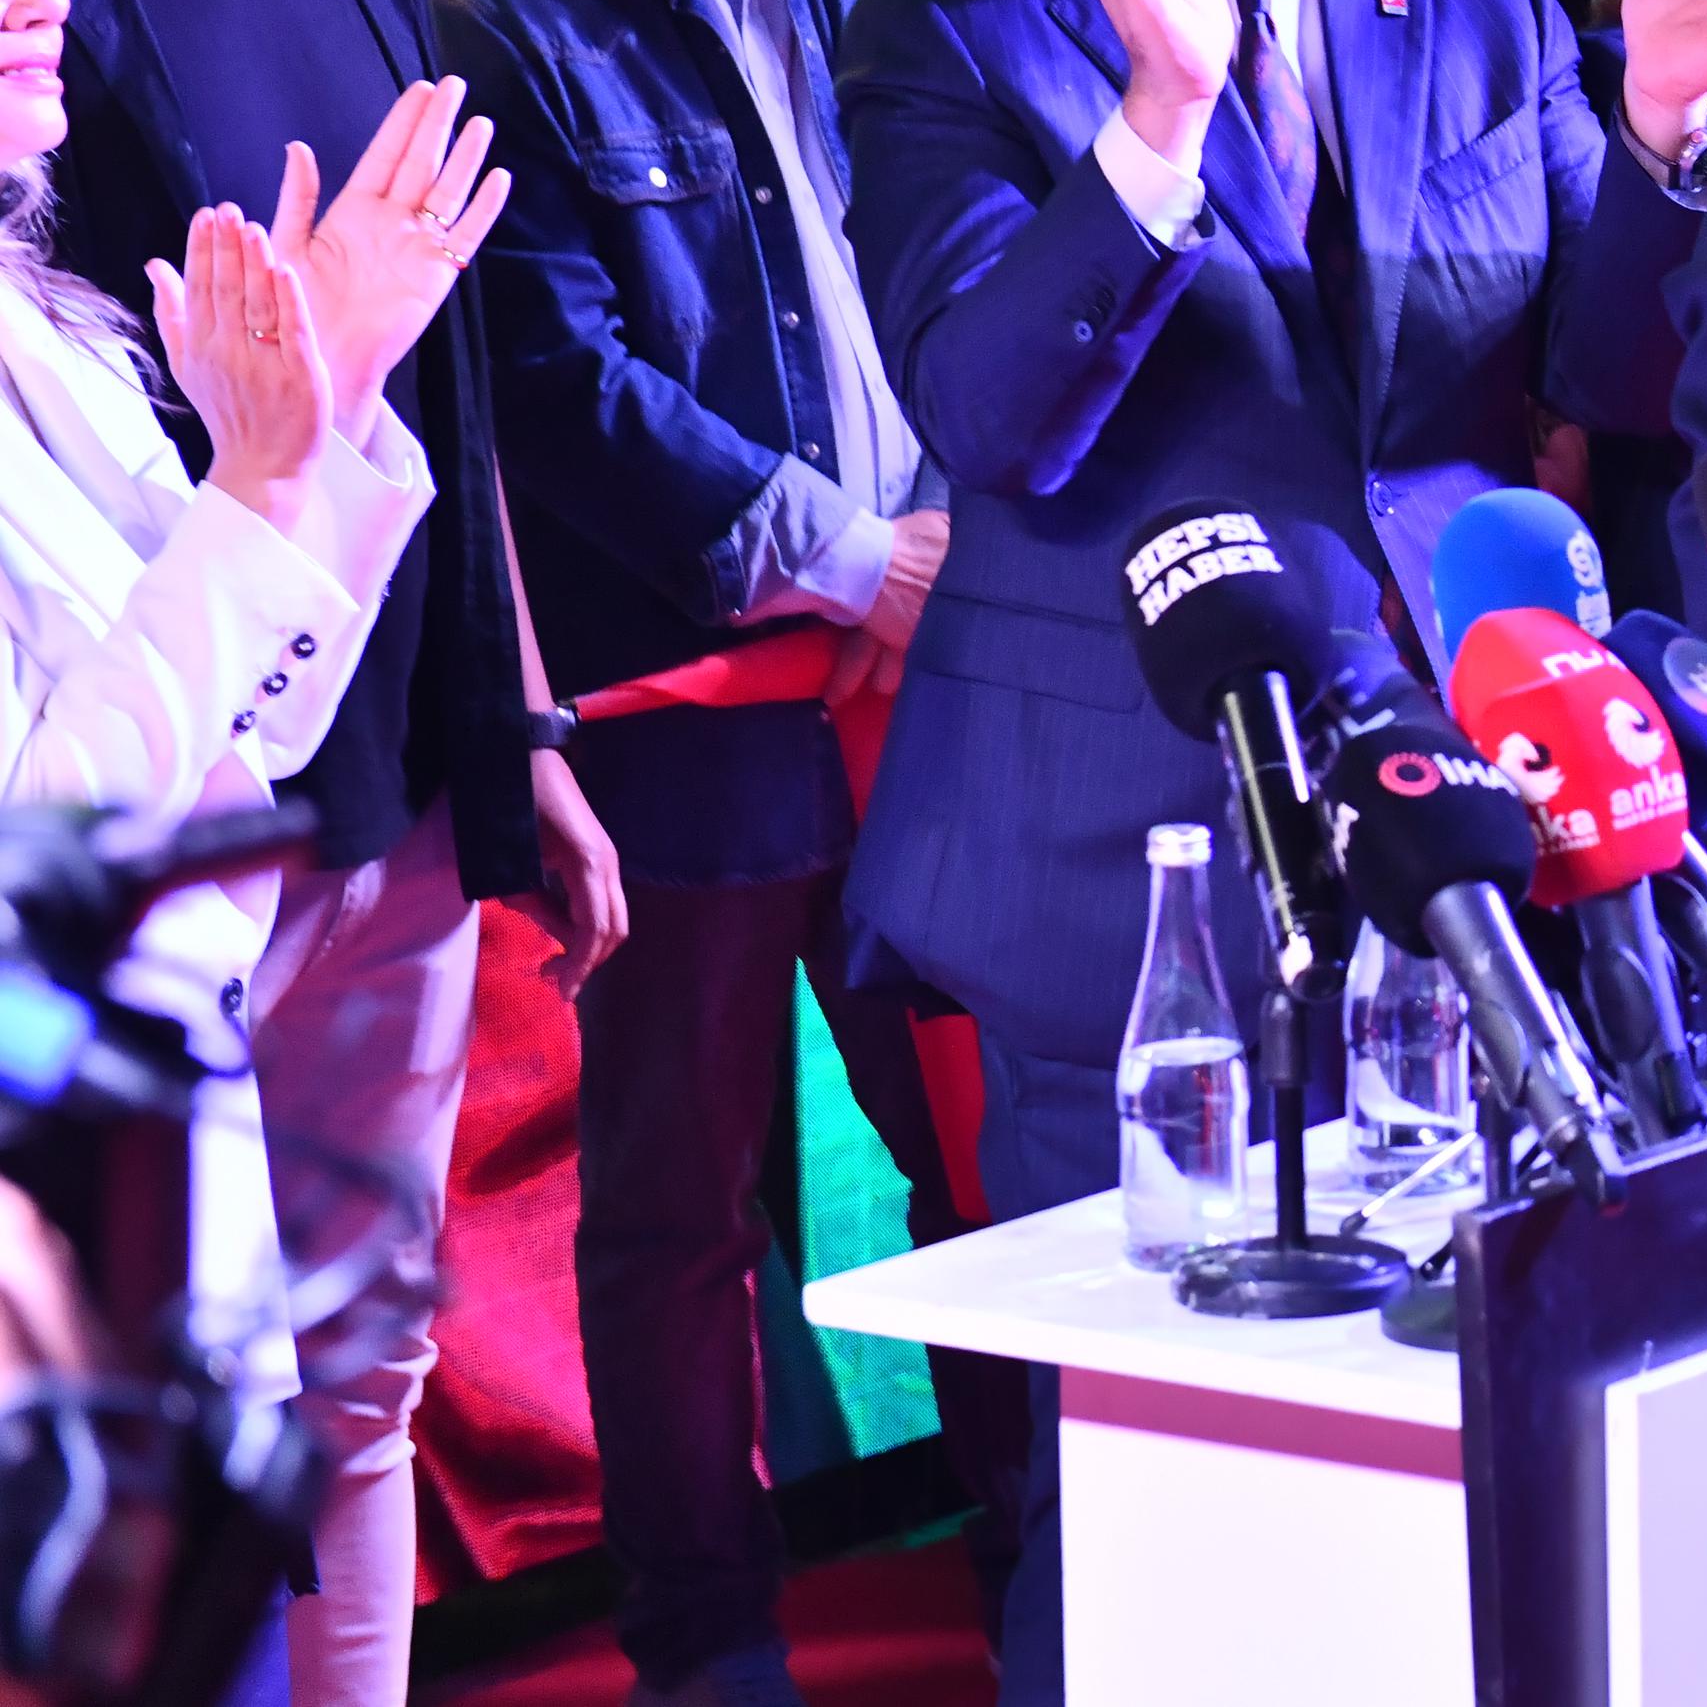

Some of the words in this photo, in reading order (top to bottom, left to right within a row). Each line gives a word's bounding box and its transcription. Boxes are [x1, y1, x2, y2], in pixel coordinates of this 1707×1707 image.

[1125, 513, 1268, 595] HEPSI
[1138, 545, 1284, 626] HABER
[1610, 764, 1687, 816] anka
